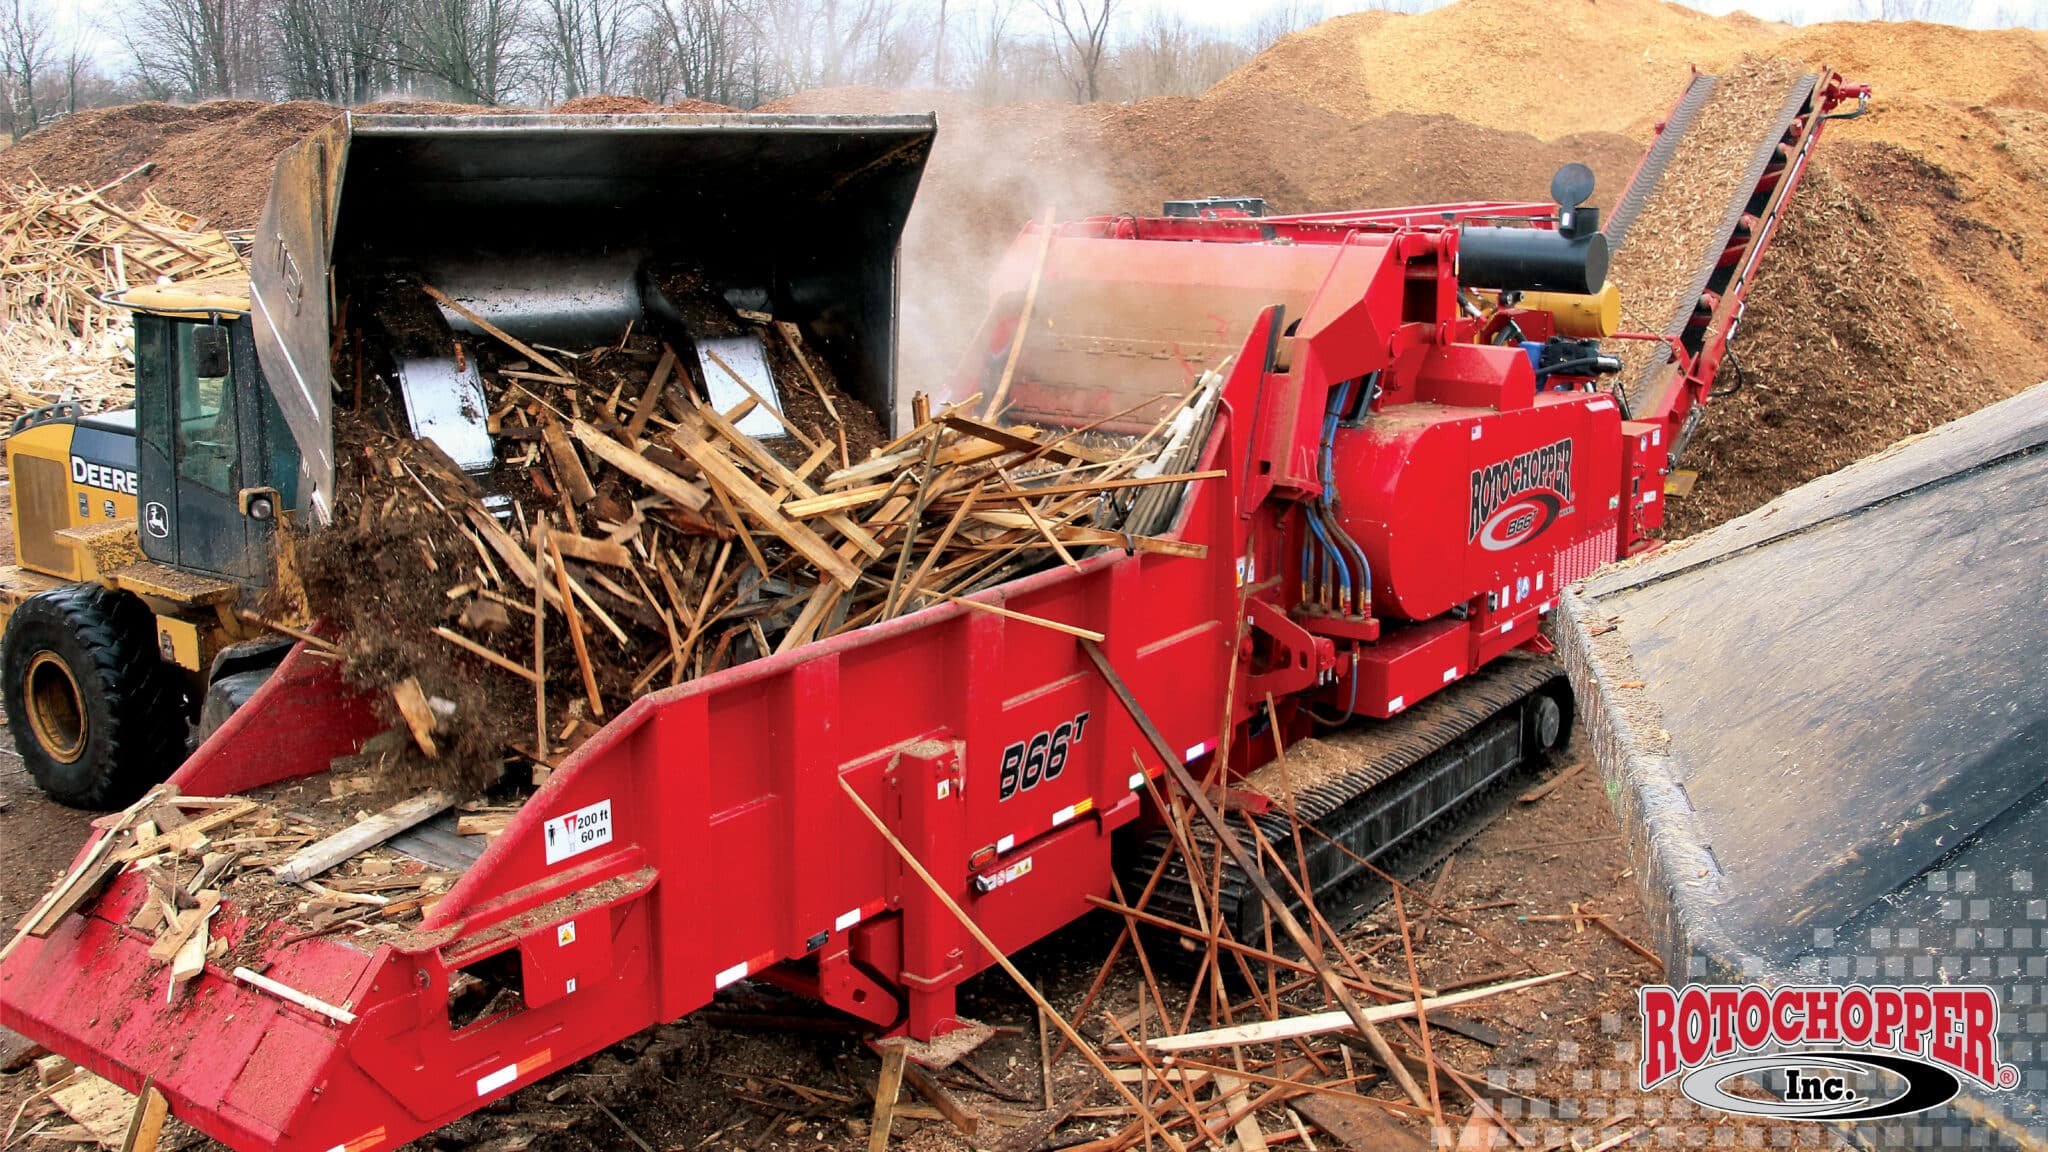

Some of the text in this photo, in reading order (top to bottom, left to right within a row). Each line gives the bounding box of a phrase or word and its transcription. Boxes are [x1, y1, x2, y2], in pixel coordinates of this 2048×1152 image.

[71, 455, 137, 495] DEERE
[1468, 437, 1572, 544] ROTOCHOPPER
[1000, 710, 1090, 802] B66T
[577, 808, 609, 830] 200 ft
[581, 827, 607, 843] 60 m
